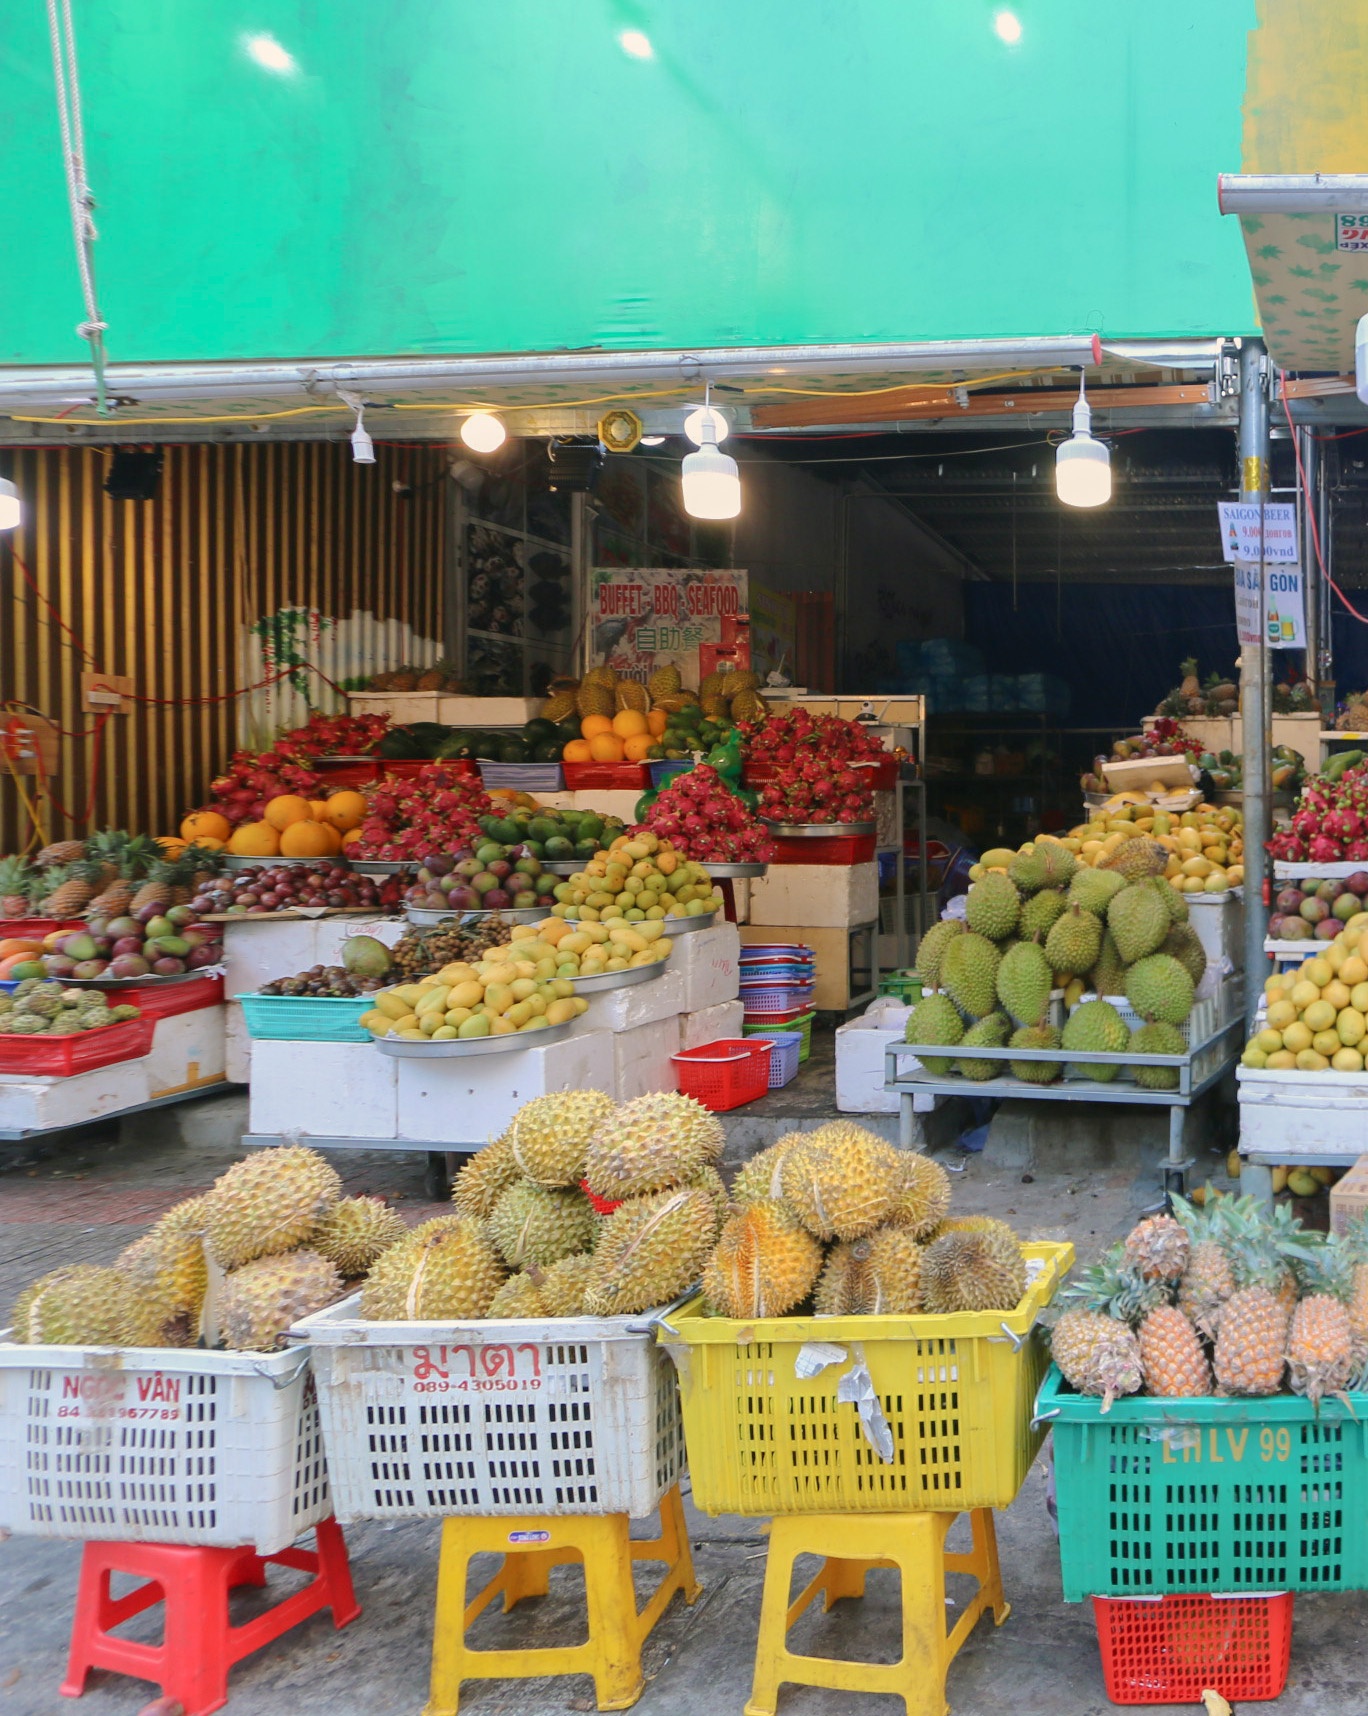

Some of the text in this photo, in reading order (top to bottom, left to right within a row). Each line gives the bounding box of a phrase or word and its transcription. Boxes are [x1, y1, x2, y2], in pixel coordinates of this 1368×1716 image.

[1223, 508, 1290, 520] SAIGON BEER
[1269, 569, 1298, 592] GÒN
[599, 584, 643, 615] BUFFET
[654, 585, 679, 619] BBQ
[688, 585, 739, 616] SEAFOOD
[636, 626, 704, 651] 自助餐
[137, 1370, 180, 1403] VÂN
[413, 1378, 542, 1392] 089-4305019
[57, 1405, 80, 1418] 84
[1259, 1427, 1291, 1462] 99
